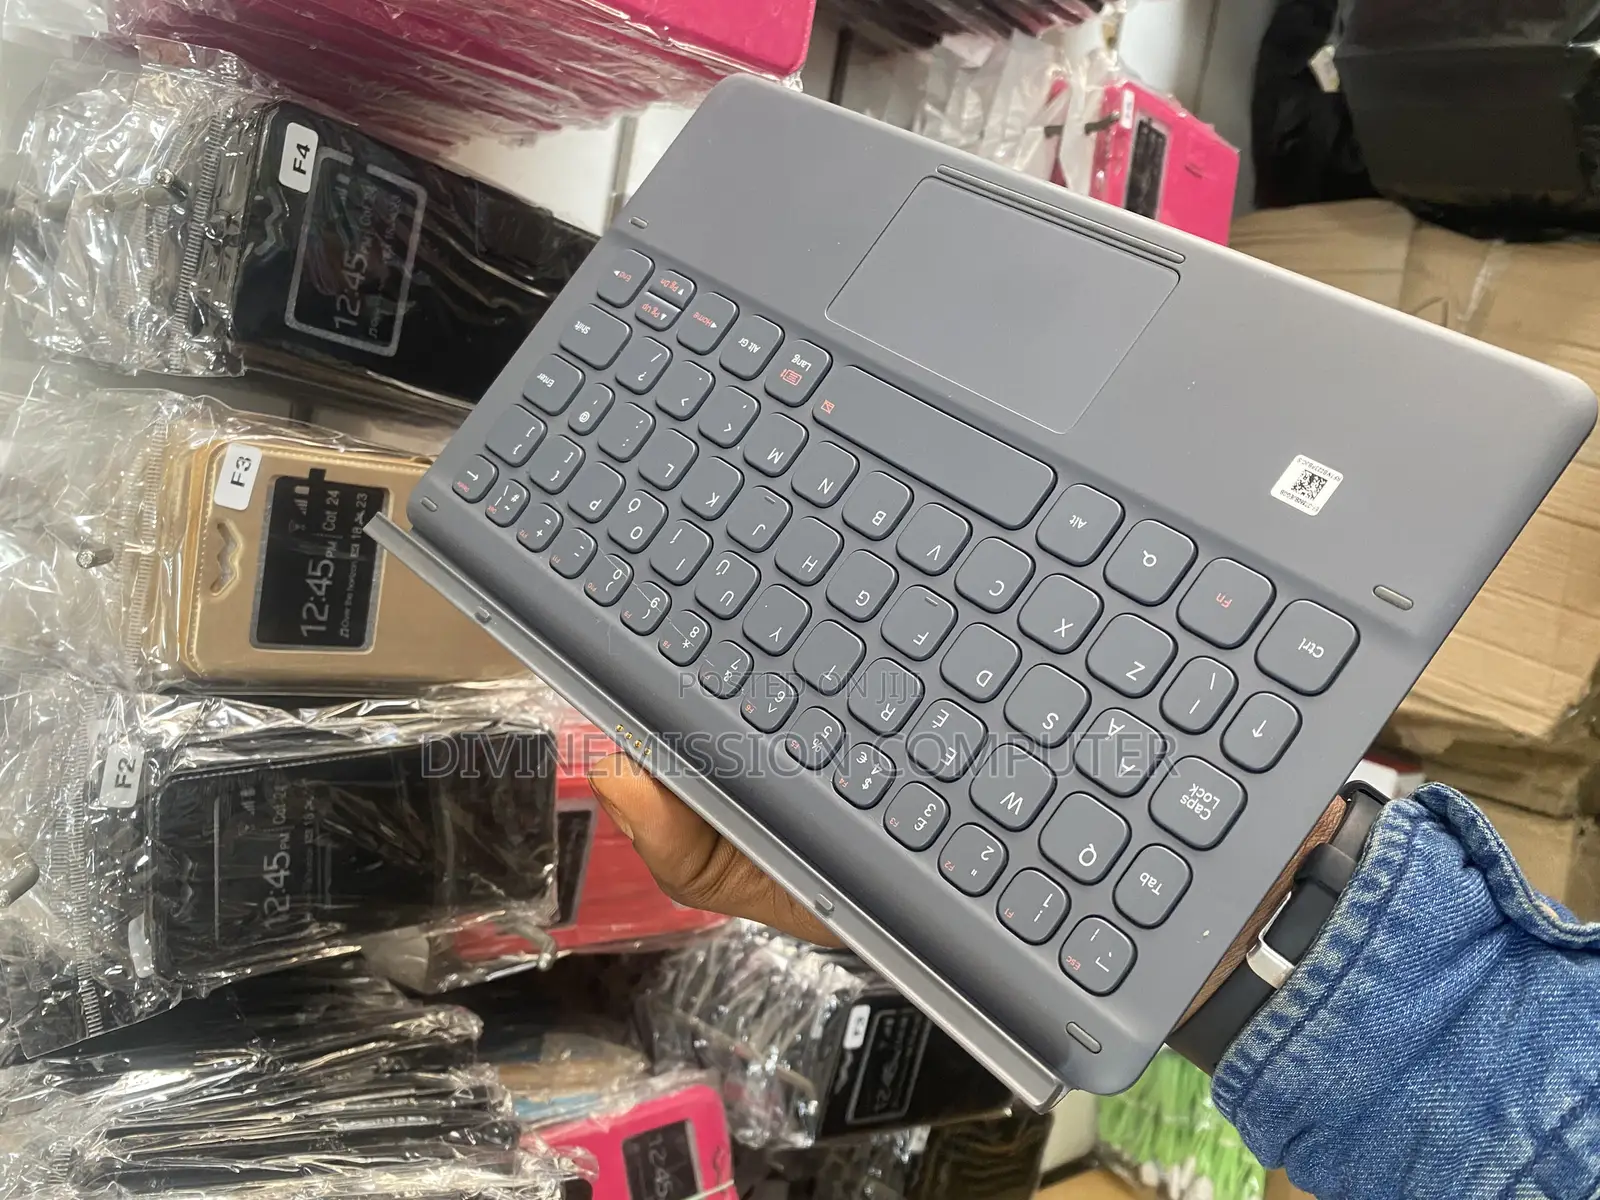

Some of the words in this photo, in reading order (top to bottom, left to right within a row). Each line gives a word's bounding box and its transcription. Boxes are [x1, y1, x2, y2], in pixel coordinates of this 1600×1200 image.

[293, 142, 311, 175] F4
[618, 270, 632, 282] End
[660, 278, 670, 287] Dn
[333, 253, 369, 329] 12:45
[669, 281, 680, 292] Pg
[642, 302, 652, 312] Up
[652, 306, 661, 318] Pg
[693, 311, 713, 327] Home
[574, 320, 591, 335] Shift
[738, 337, 749, 347] Gr
[748, 342, 761, 354] Alt
[791, 353, 812, 372] Lang
[536, 372, 555, 387] Enter
[767, 447, 784, 464] M
[230, 456, 252, 488] F3
[665, 463, 675, 478] L
[817, 477, 834, 495] N
[325, 489, 341, 507] 24
[356, 492, 368, 508] 23
[589, 498, 602, 511] P
[705, 491, 720, 508] K
[872, 510, 887, 527] B
[1069, 514, 1087, 530] Alt
[351, 526, 363, 539] 18
[630, 526, 643, 540] O
[752, 523, 766, 536] J
[325, 541, 337, 559] PM
[926, 544, 942, 561] V
[801, 555, 819, 573] H
[612, 569, 623, 580] 0
[988, 580, 1005, 596] C
[300, 559, 335, 638] 12:45
[650, 597, 661, 608] 9
[719, 590, 735, 607] U
[855, 590, 871, 607] G
[1216, 592, 1233, 609] Fn
[689, 626, 700, 638] 8
[768, 626, 783, 642] Y
[1053, 618, 1074, 637] X
[913, 631, 929, 646] F
[1298, 637, 1325, 659] Ctrl
[730, 658, 741, 670] 7
[1125, 660, 1145, 681] Z
[823, 665, 837, 681] T
[976, 670, 994, 688] D
[774, 690, 786, 703] 6
[880, 703, 896, 722] R
[932, 708, 950, 729] É
[1042, 712, 1059, 730] S
[821, 725, 833, 739] 5
[940, 746, 958, 766] E
[114, 757, 137, 789] F2
[871, 763, 883, 775] 4
[1118, 757, 1136, 778] A
[999, 791, 1024, 815] W
[1188, 782, 1221, 810] Lock
[924, 803, 937, 817] 3
[1180, 794, 1212, 821] Caps
[889, 817, 900, 827] F3
[980, 845, 995, 861] 2
[1078, 843, 1098, 867] Q
[944, 860, 956, 872] F2
[261, 851, 291, 929] 12:45
[1139, 871, 1164, 896] Tab
[1042, 893, 1053, 908] 1
[1004, 908, 1015, 919] F1
[1066, 955, 1081, 971] Esc
